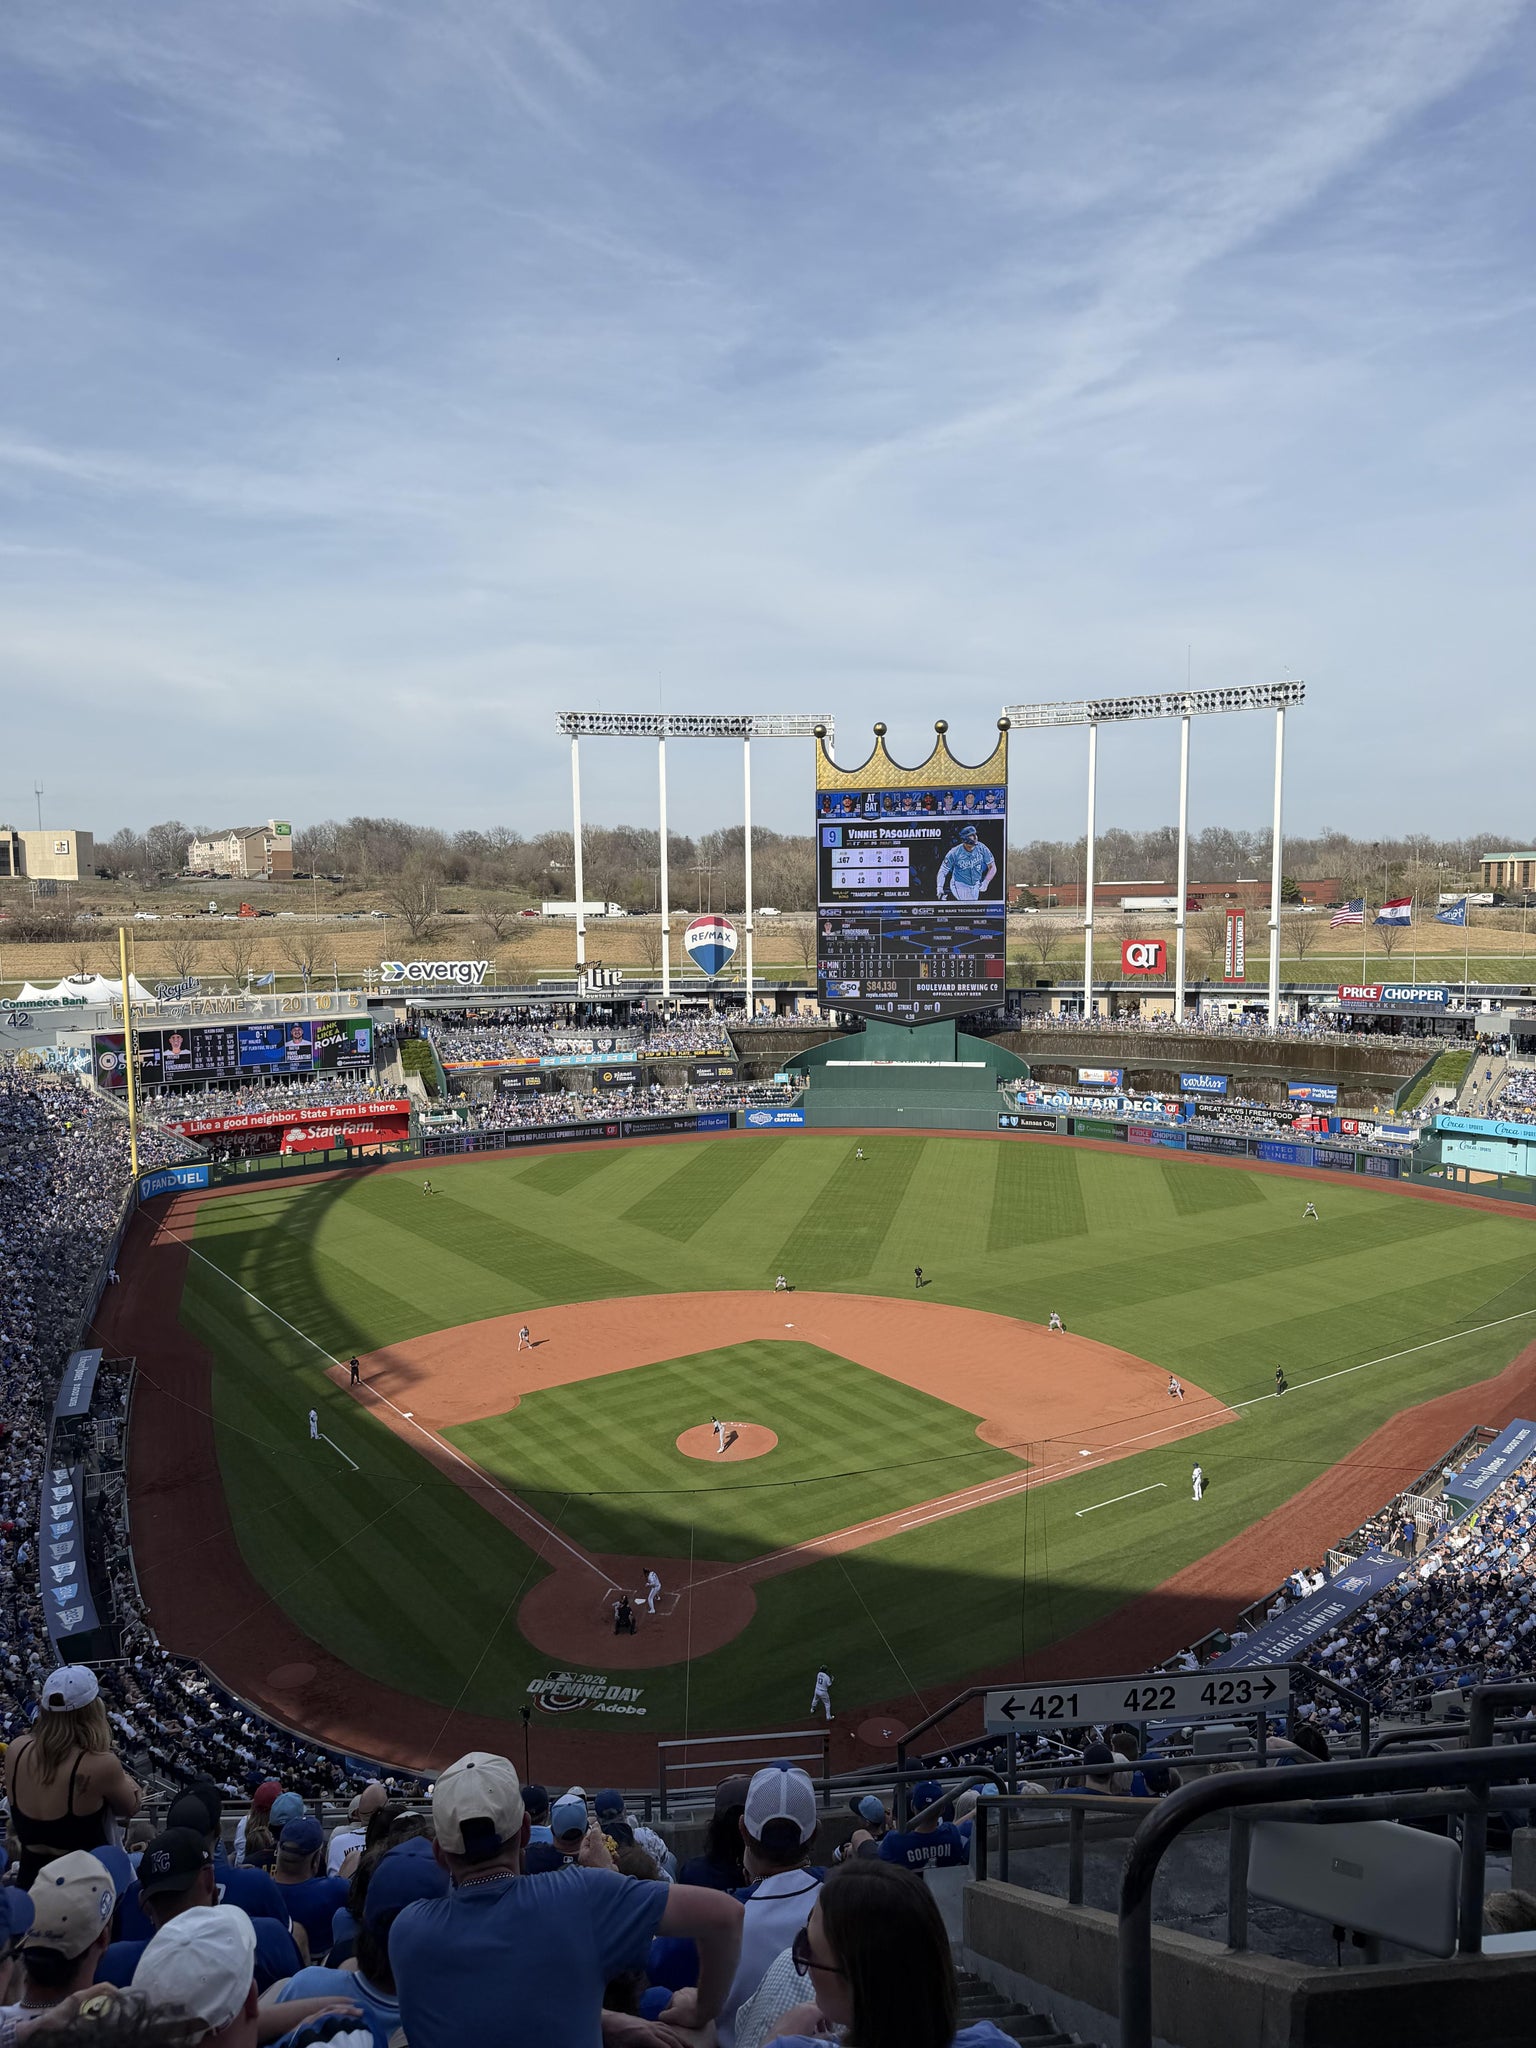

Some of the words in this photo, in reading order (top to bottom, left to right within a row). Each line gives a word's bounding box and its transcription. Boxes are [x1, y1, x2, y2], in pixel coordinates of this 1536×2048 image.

[867, 793, 875, 802] AT
[865, 803, 877, 812] BAT
[829, 831, 837, 844] 9
[848, 829, 878, 839] VINNIE
[879, 828, 942, 838] PASQUANTINO
[959, 855, 983, 870] Royals
[691, 931, 731, 943] RE/MAX
[1225, 920, 1233, 972] BOULEVARD
[1236, 920, 1244, 972] BOULEVARD
[1126, 944, 1160, 968] QT
[408, 962, 488, 984] evergy
[584, 968, 624, 992] Lite
[155, 976, 201, 1001] Royals
[866, 981, 897, 992] $84,130
[348, 994, 359, 1008] 5
[1342, 986, 1377, 998] PRICE
[1384, 988, 1444, 1002] CHOPPER
[2, 997, 60, 1010] Commerce
[62, 995, 89, 1006] Bank
[111, 1001, 168, 1020] HALL
[170, 1002, 188, 1019] of
[190, 999, 246, 1016] FAME
[281, 998, 301, 1011] 20
[315, 996, 331, 1009] 10
[7, 1012, 30, 1028] 42
[317, 1021, 338, 1033] BANK
[314, 1031, 349, 1050] ROYAL
[316, 1030, 334, 1040] LIKE
[614, 1071, 633, 1079] planet
[1182, 1075, 1224, 1089] carbliss
[1043, 1094, 1119, 1111] FOUNTAIN
[1123, 1099, 1163, 1112] DECK
[1166, 1104, 1177, 1112] QT
[190, 1121, 213, 1133] Like
[223, 1116, 248, 1131] good
[250, 1112, 299, 1128] neighbor,
[300, 1108, 328, 1121] State
[330, 1106, 356, 1118] Farm
[357, 1105, 367, 1115] is
[368, 1103, 398, 1115] there.
[1216, 1112, 1250, 1121] ICE-COLD
[1222, 1106, 1245, 1115] VIEWS
[1248, 1109, 1272, 1117] FRESH
[1272, 1112, 1293, 1120] FOOD
[673, 1121, 683, 1129] The
[683, 1120, 697, 1128] Right
[1020, 1119, 1042, 1127] Kansas
[1043, 1120, 1056, 1129] City
[1343, 1121, 1355, 1131] QT
[1441, 1116, 1465, 1130] Circa
[1495, 1123, 1520, 1136] Circa
[532, 1133, 547, 1141] PLACE
[556, 1130, 576, 1138] OPENING
[1131, 1128, 1149, 1137] PRICE
[1152, 1132, 1183, 1140] CHOPPER
[1188, 1134, 1214, 1143] SUNDAY
[1257, 1142, 1293, 1153] UNITED
[1459, 1140, 1478, 1151] Circa
[1248, 1149, 1294, 1160] AIRLINES
[151, 1171, 205, 1192] FANDUEL
[1366, 1554, 1395, 1565] KC
[64, 1608, 81, 1623] 2024
[1267, 1633, 1304, 1657] SERIES
[1298, 1602, 1347, 1635] CHAMPIONS
[1246, 1637, 1276, 1657] HOME
[1276, 1625, 1291, 1635] OF
[576, 1673, 608, 1686] 2026
[526, 1678, 607, 1700] OPENING
[604, 1685, 644, 1702] DAY
[1029, 1693, 1079, 1720] 421
[1123, 1685, 1176, 1713] 422
[1200, 1679, 1251, 1707] 423
[592, 1702, 648, 1716] Adobe
[906, 1843, 951, 1863] GORDON
[151, 1850, 171, 1873] KC
